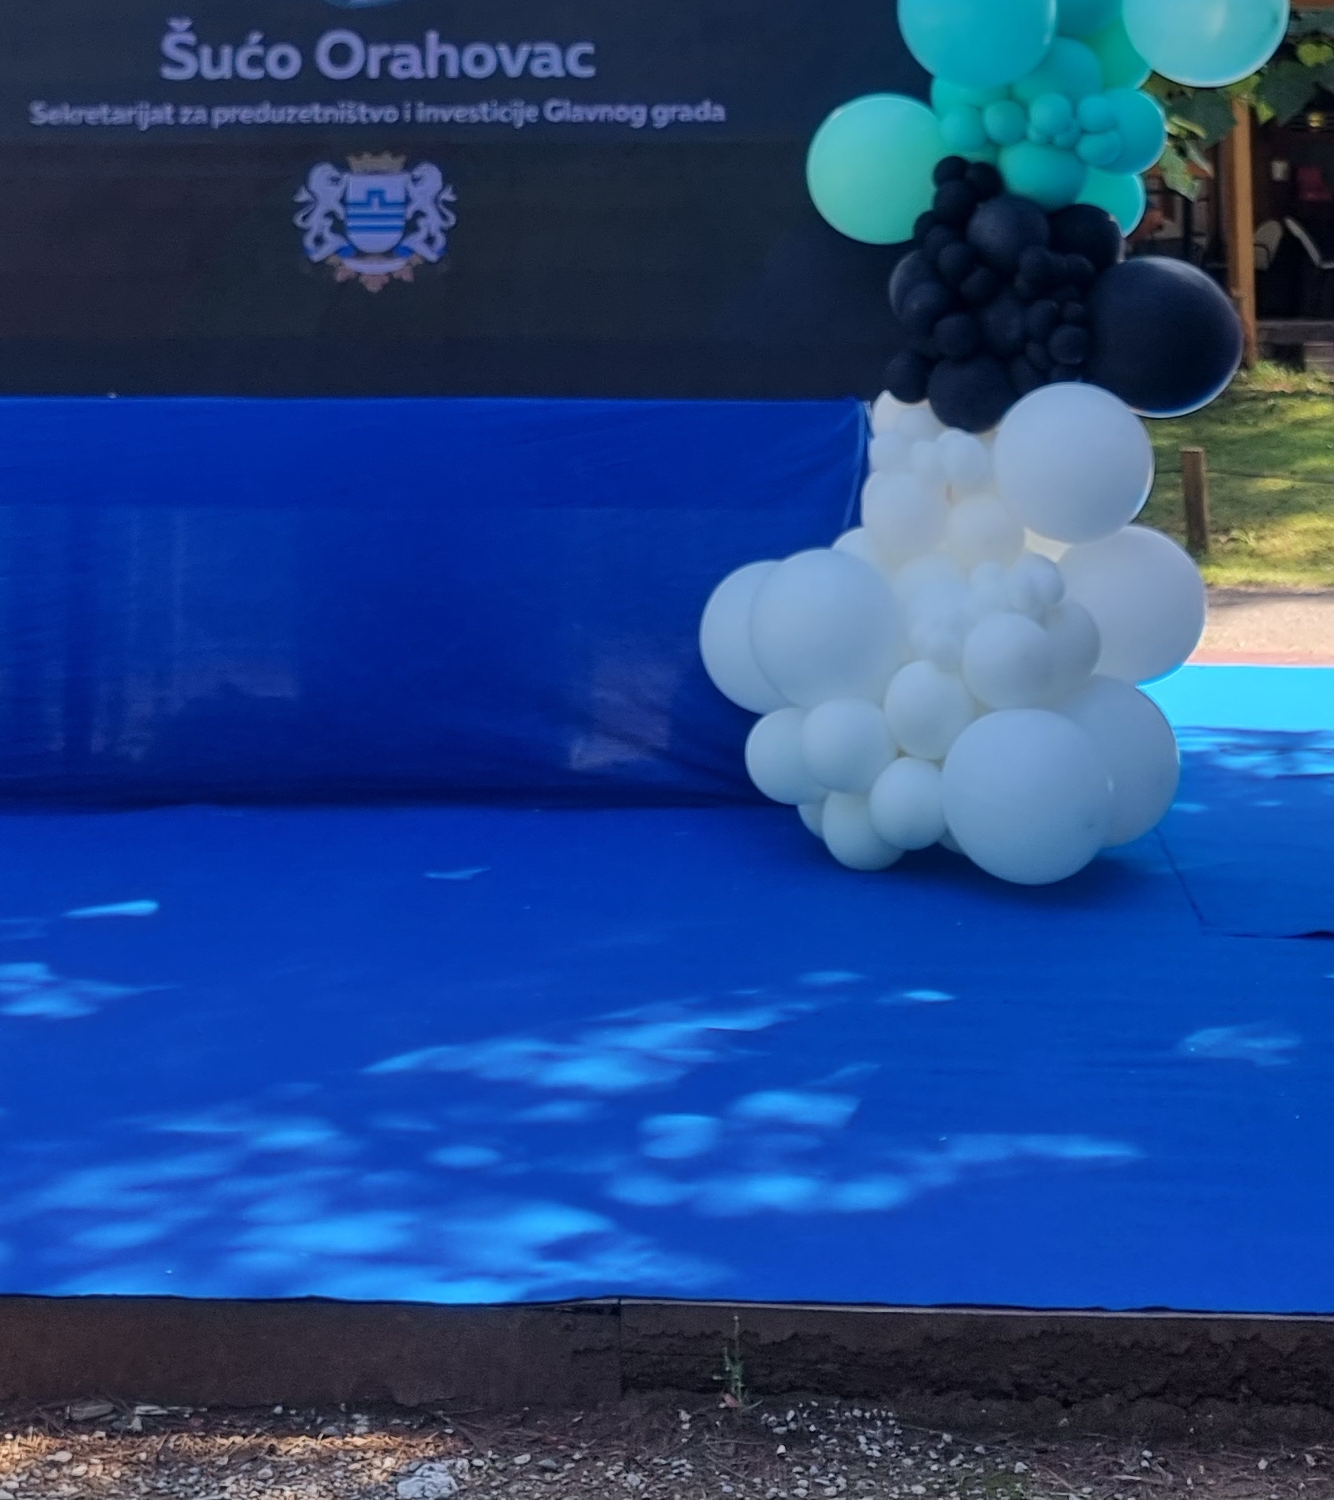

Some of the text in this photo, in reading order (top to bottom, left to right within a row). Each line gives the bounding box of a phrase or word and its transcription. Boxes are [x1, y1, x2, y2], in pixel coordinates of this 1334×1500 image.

[160, 17, 596, 81] Šućo Orahovac
[28, 97, 727, 131] Sekretarijat za preduzetništvo i investicije Glavnog grada
